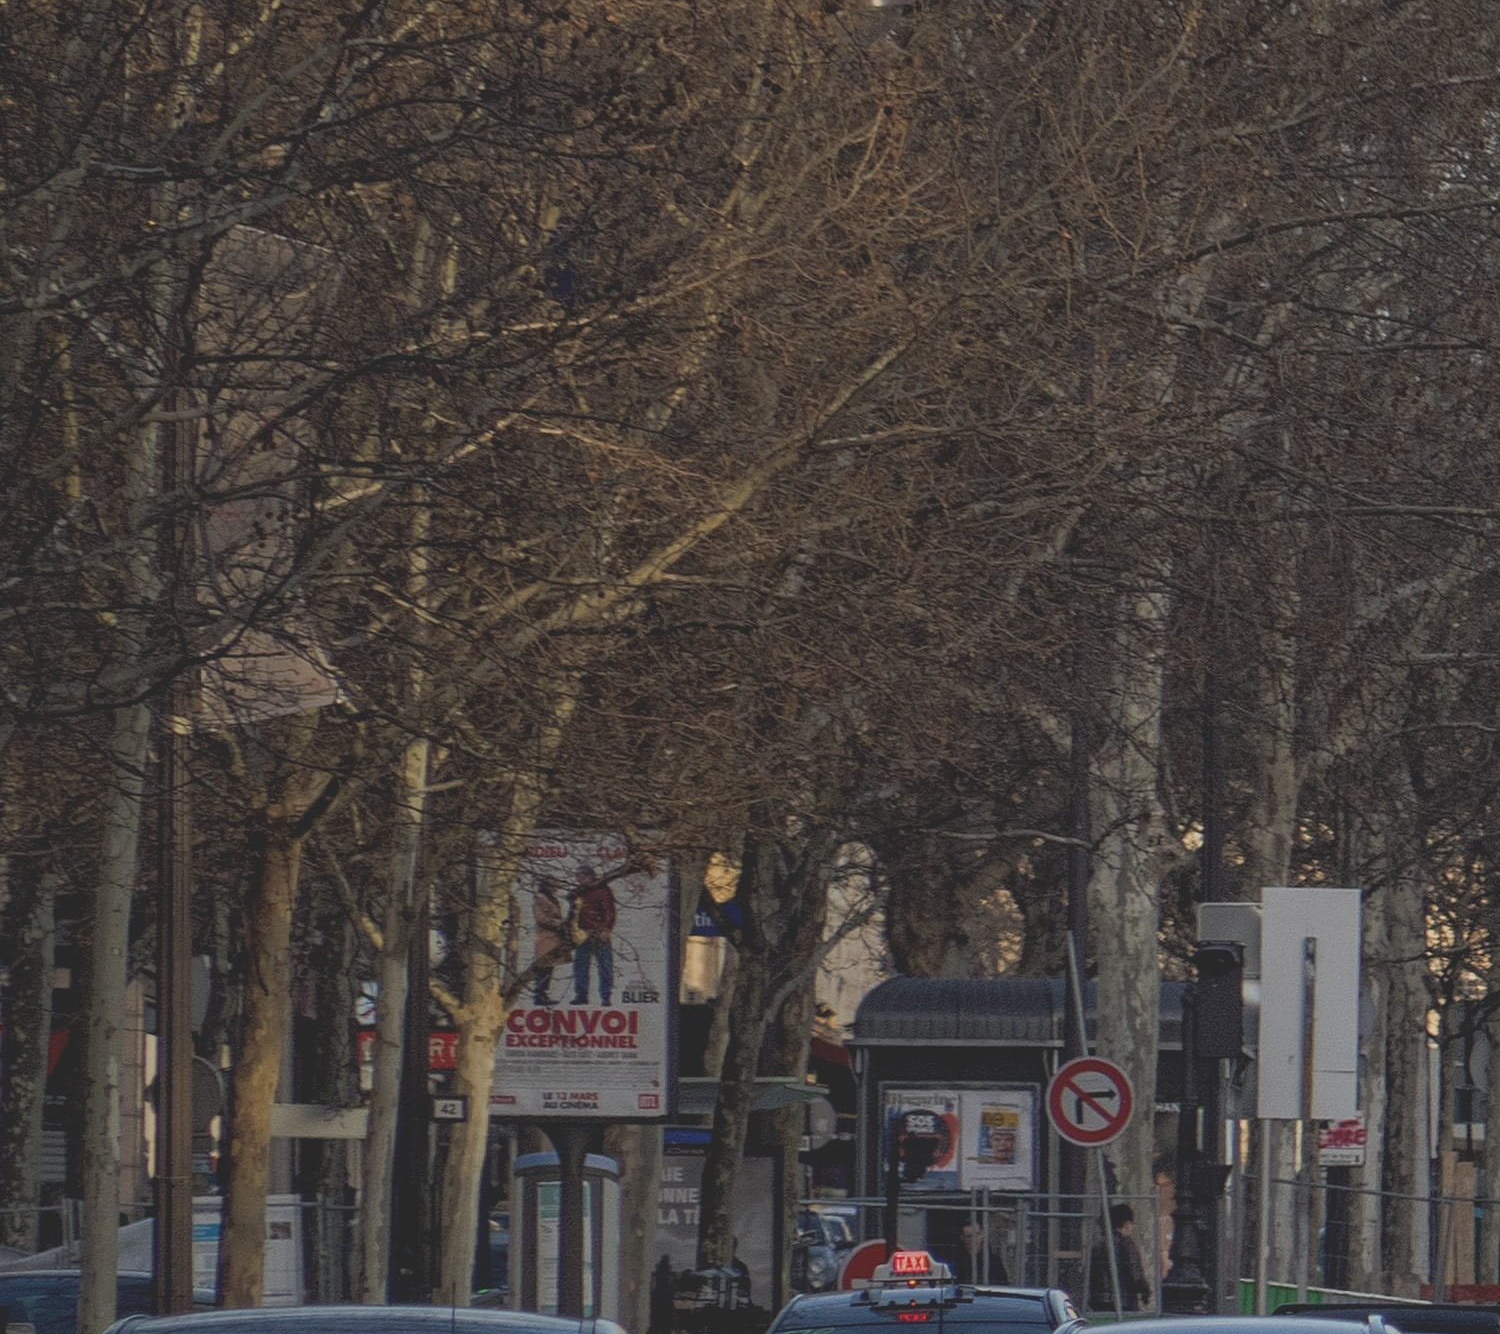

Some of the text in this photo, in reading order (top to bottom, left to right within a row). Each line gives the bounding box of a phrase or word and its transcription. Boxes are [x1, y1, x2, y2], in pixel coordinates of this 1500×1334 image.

[622, 991, 660, 1003] BLIER
[507, 1009, 638, 1034] CONVOI
[506, 1034, 637, 1048] EXCEPTIONNEL
[894, 1255, 929, 1272] TAXI
